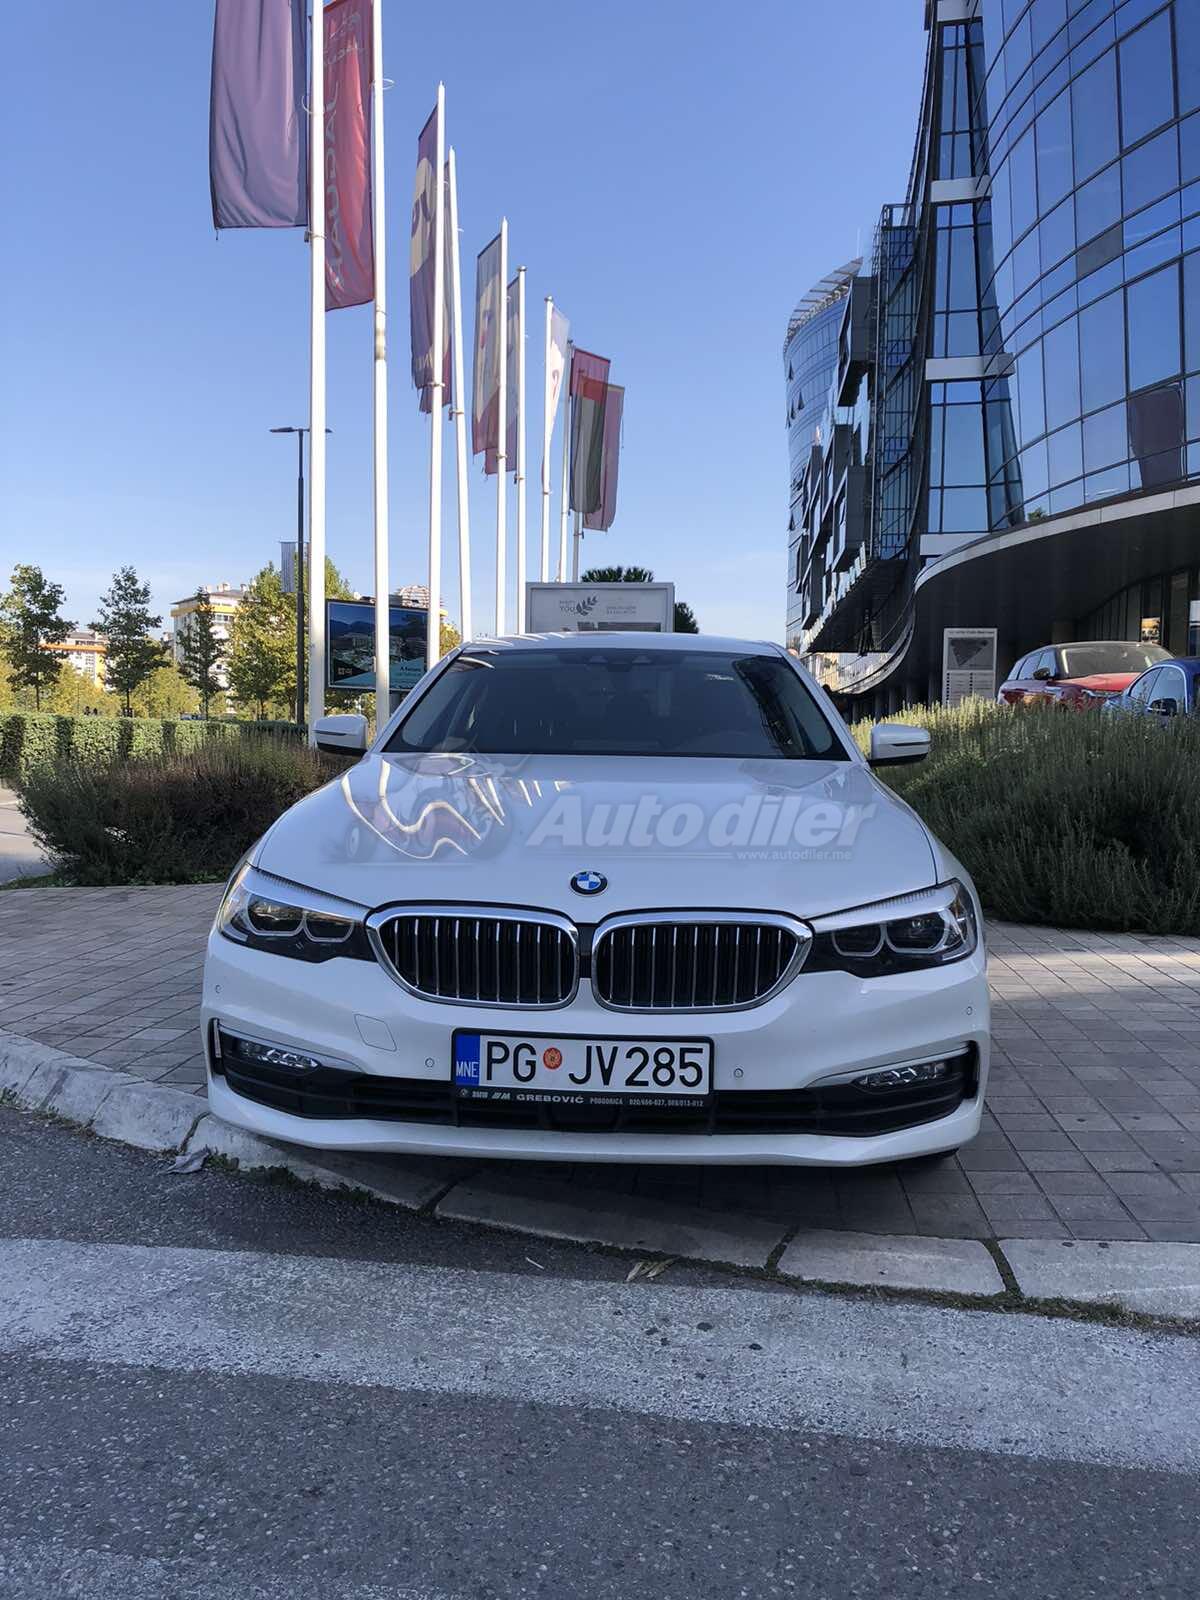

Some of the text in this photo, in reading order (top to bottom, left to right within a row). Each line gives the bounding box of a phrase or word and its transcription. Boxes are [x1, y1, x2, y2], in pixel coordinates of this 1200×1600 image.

[456, 1061, 479, 1078] MNE
[486, 1041, 703, 1088] PG JV285
[516, 1093, 584, 1104] GREBOVIĆ
